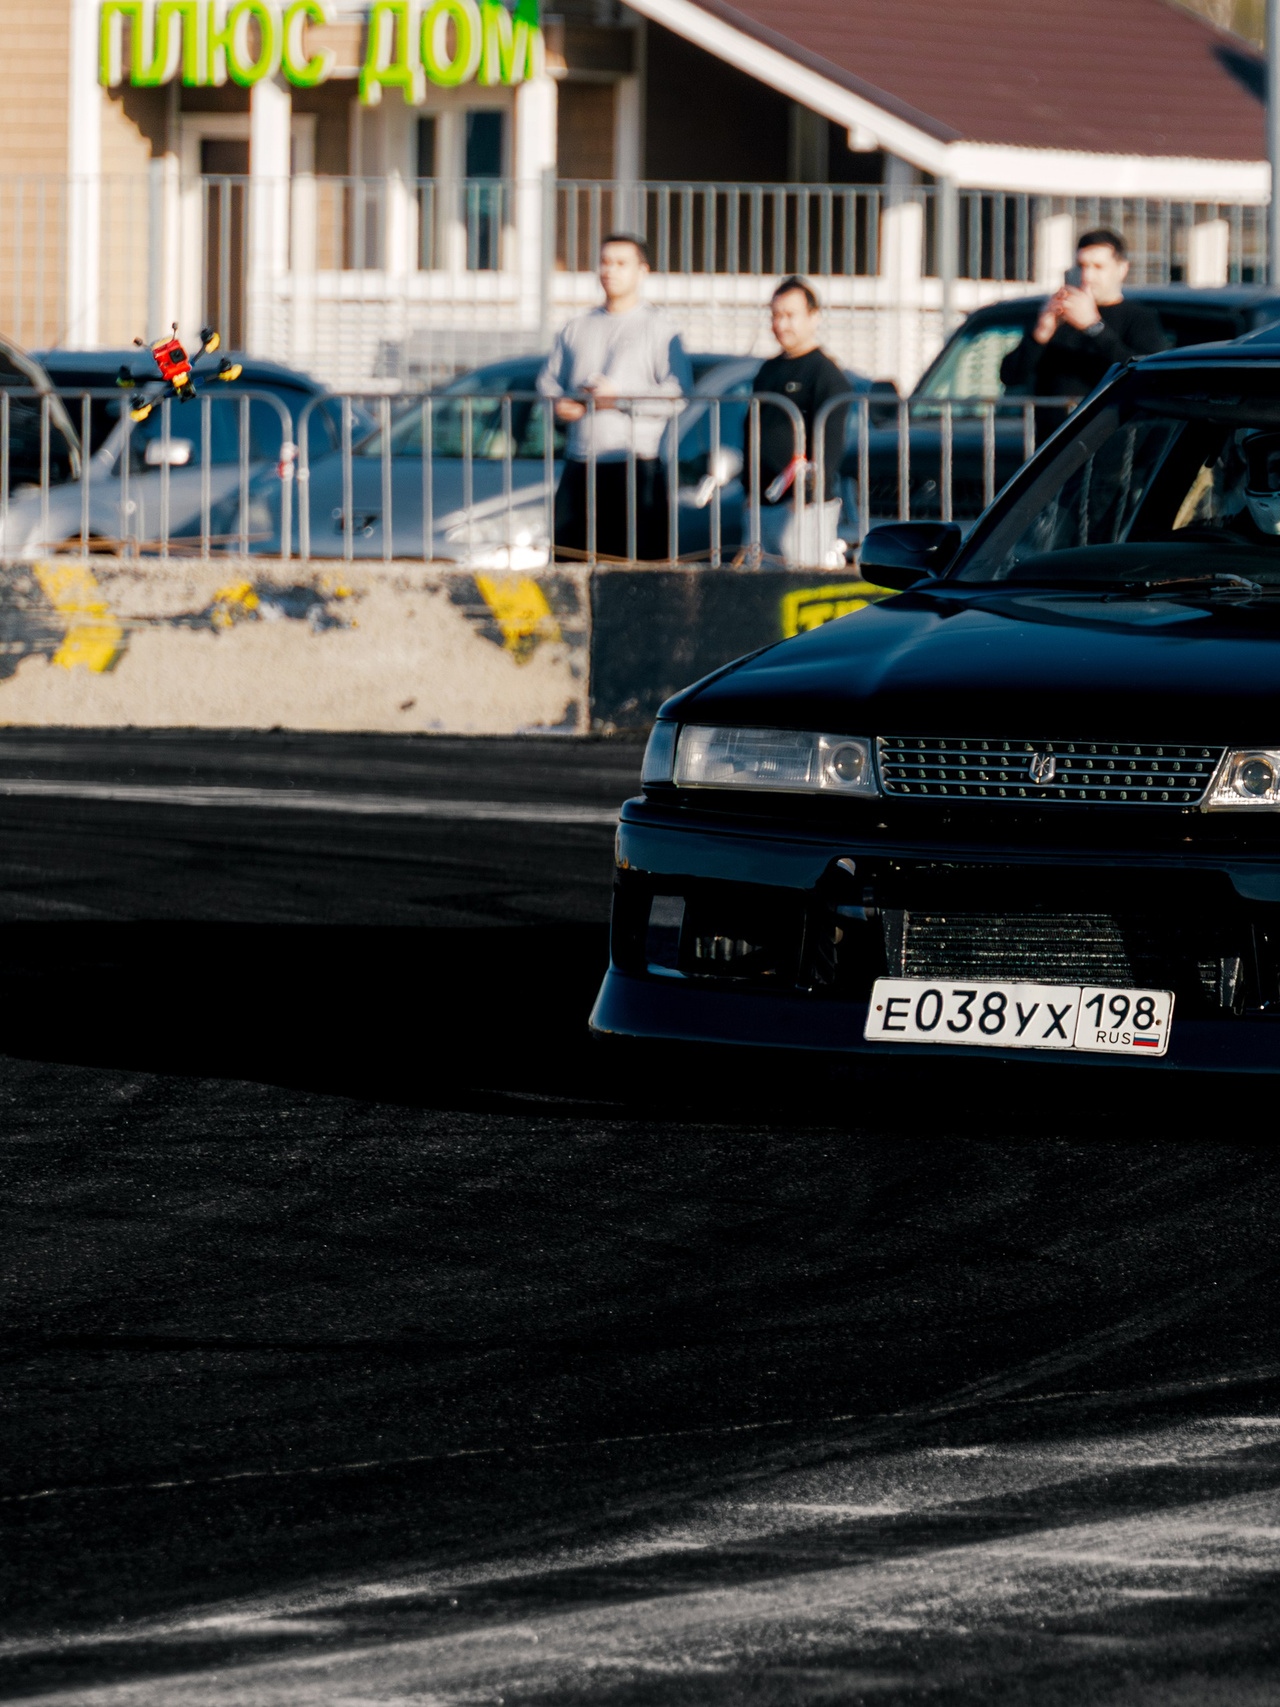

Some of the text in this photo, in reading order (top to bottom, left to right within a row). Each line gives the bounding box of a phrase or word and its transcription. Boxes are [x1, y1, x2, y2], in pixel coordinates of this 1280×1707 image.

[99, 0, 545, 106] ПЛЮС ДОМ
[1084, 993, 1156, 1031] 198
[1096, 1030, 1131, 1045] RUS
